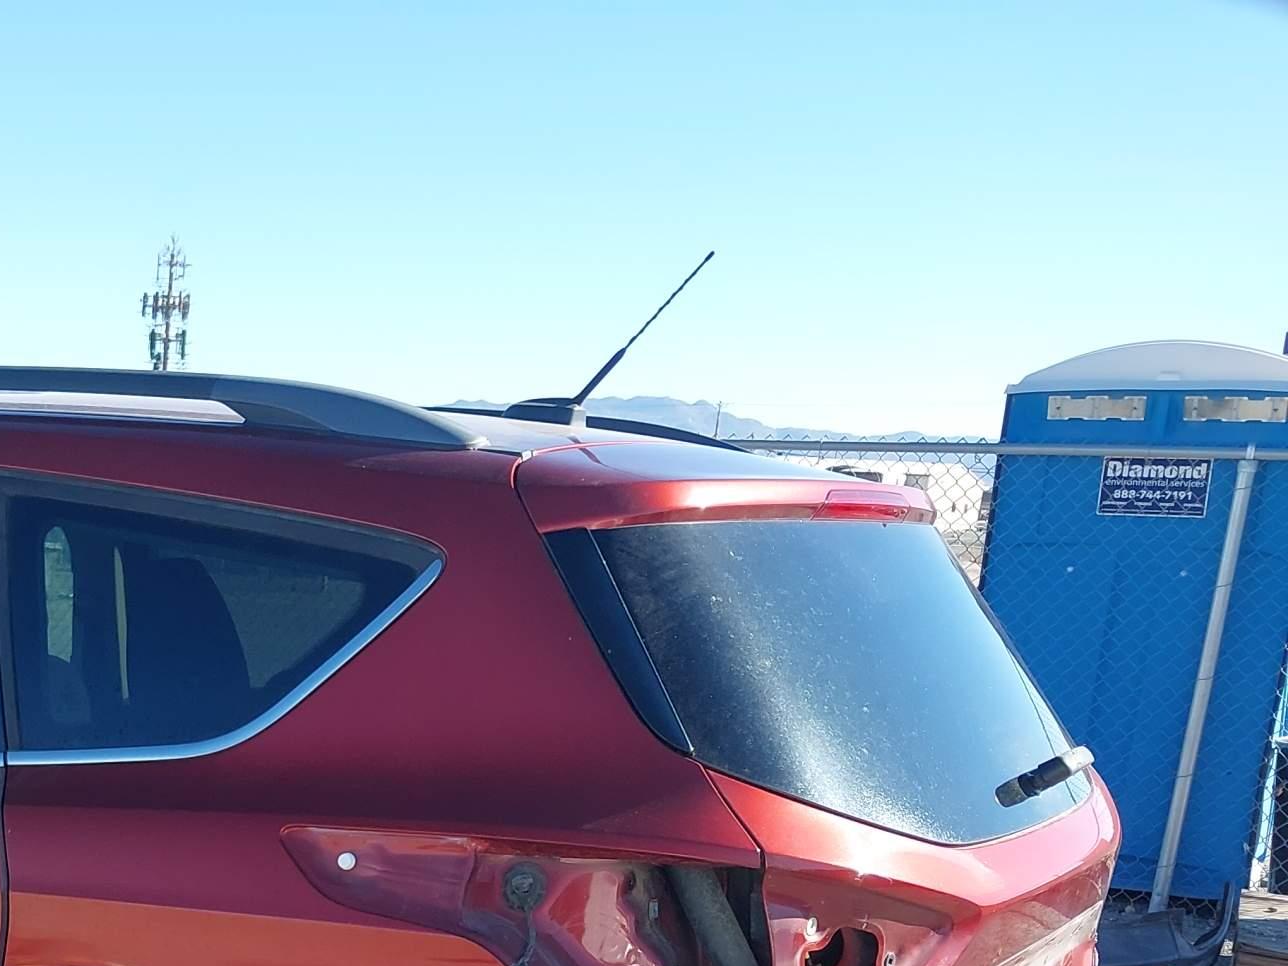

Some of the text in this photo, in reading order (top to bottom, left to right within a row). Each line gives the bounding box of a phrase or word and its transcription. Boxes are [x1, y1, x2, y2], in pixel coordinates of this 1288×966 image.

[1106, 460, 1208, 479] Diamond
[1105, 479, 1206, 488] environmental services
